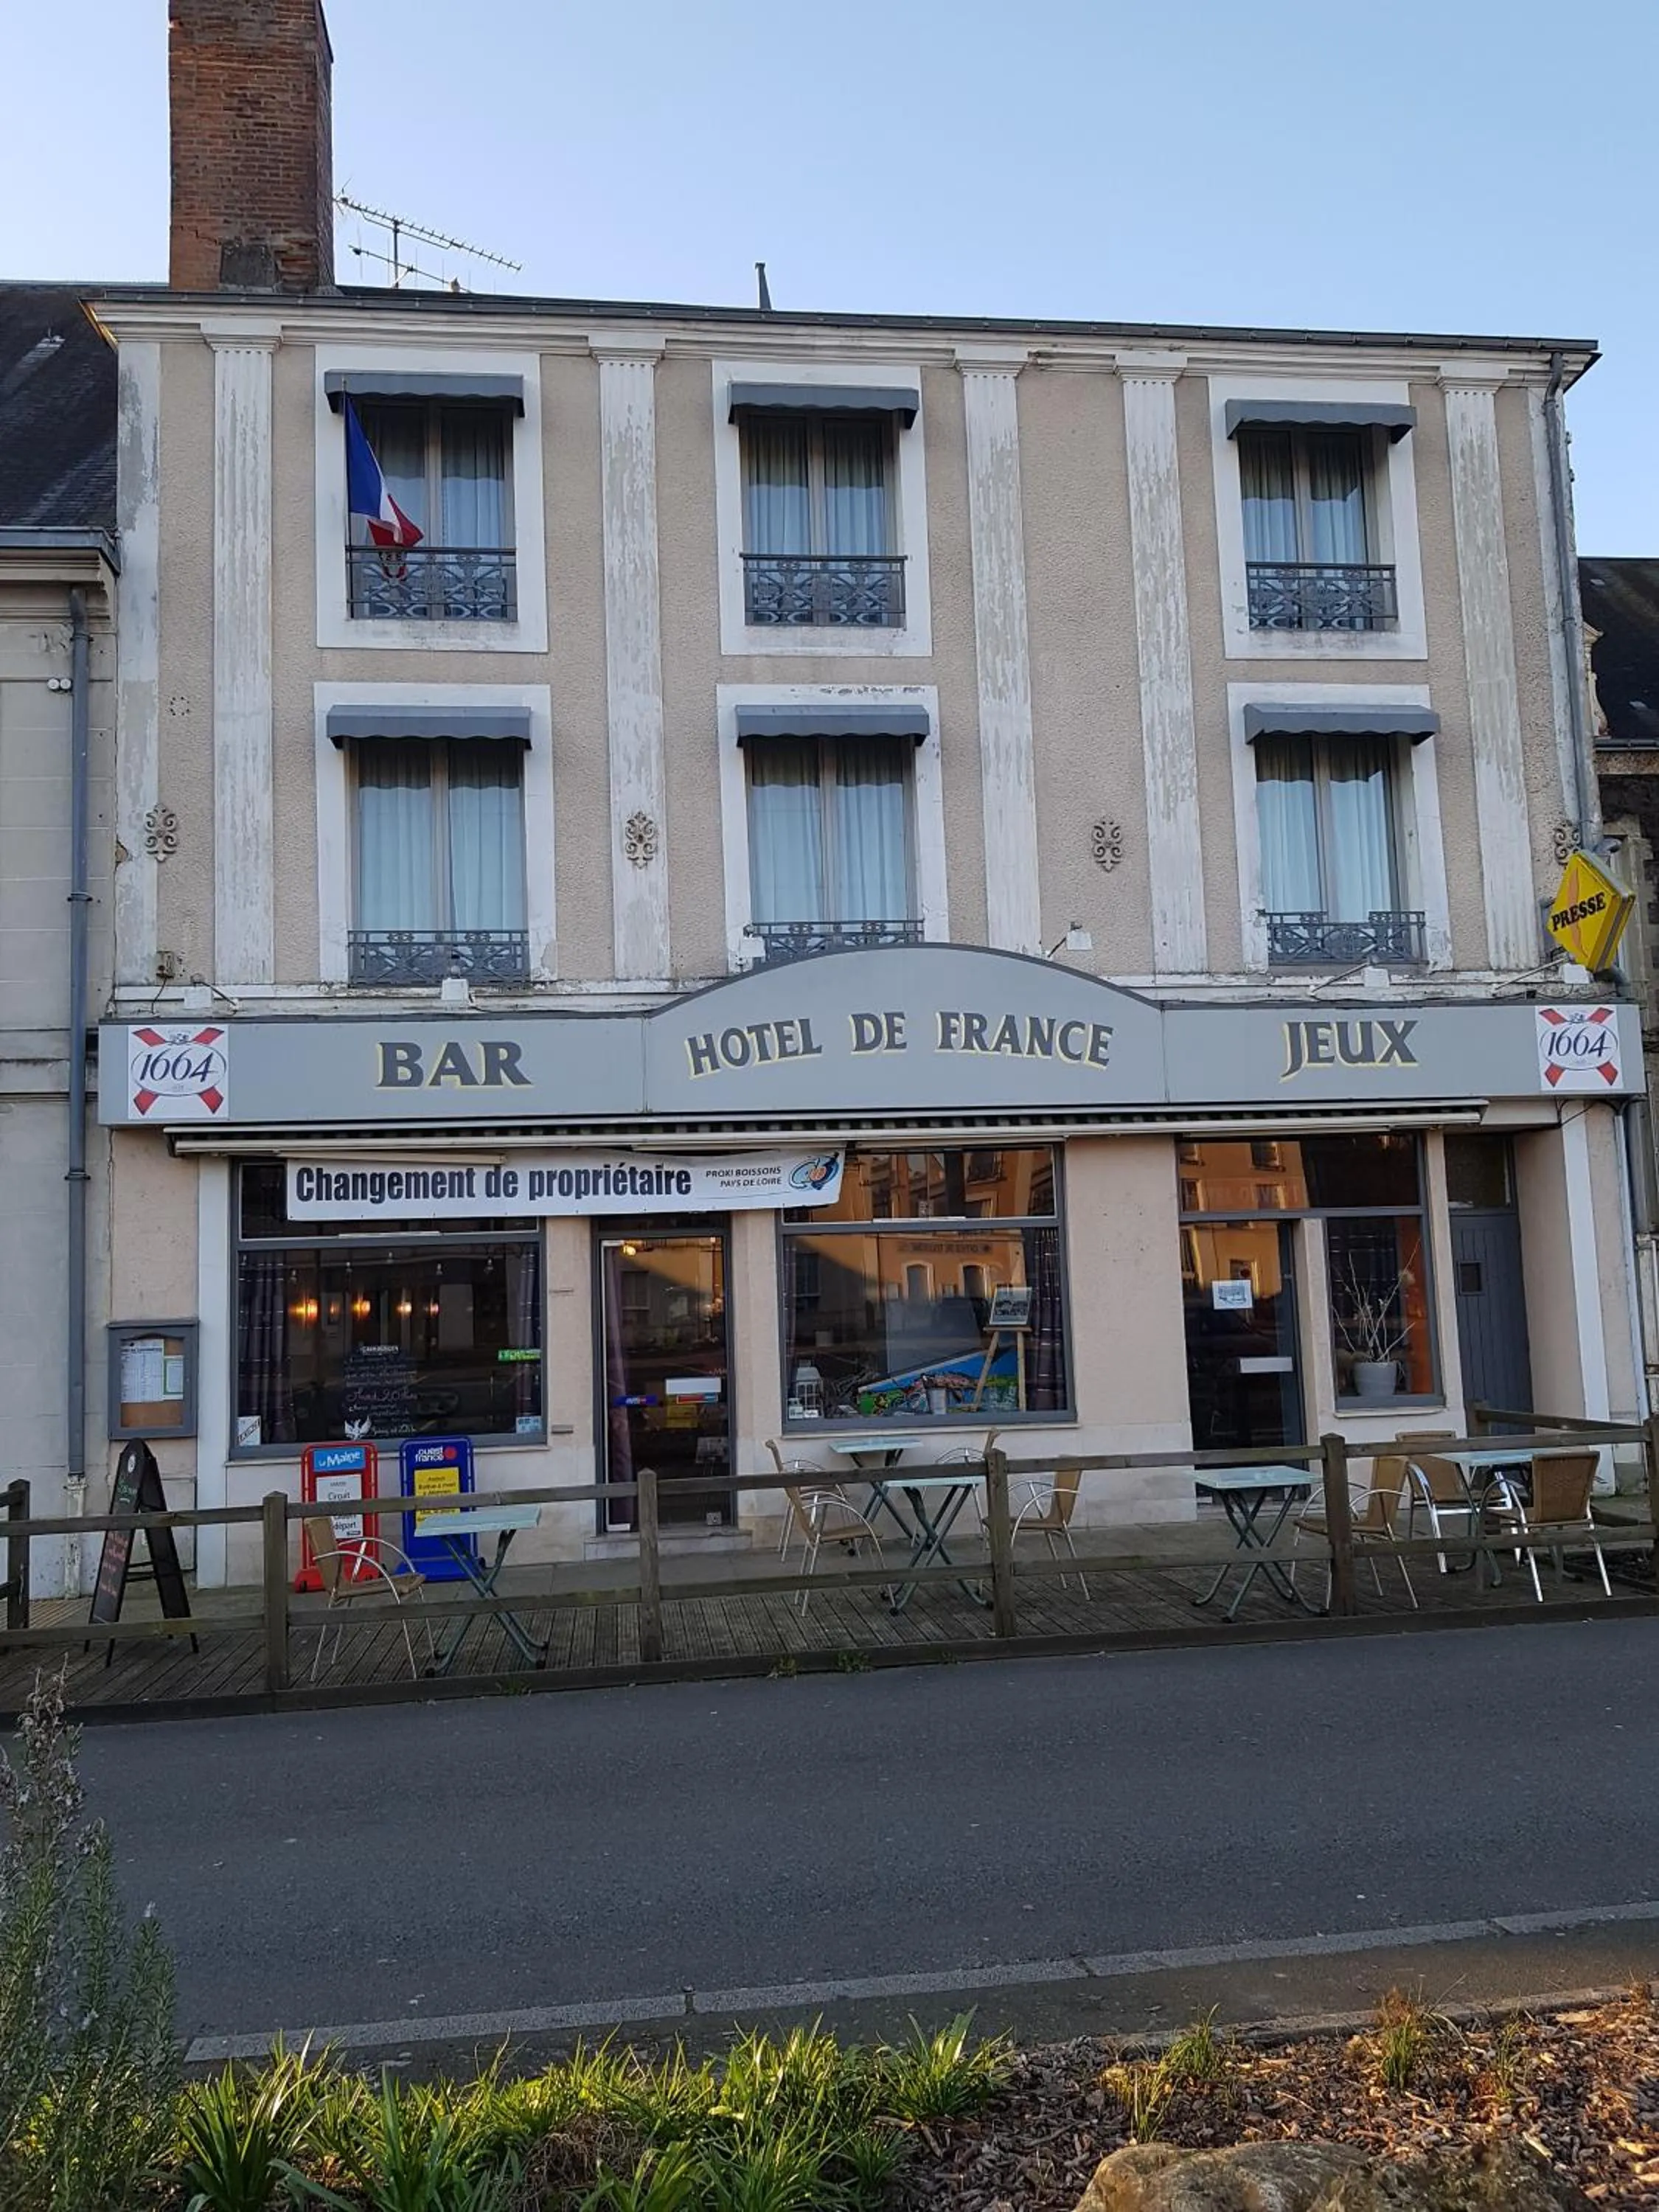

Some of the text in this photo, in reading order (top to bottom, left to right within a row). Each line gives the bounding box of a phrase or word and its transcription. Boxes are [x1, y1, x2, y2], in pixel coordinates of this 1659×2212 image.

[1551, 892, 1606, 932] PRESSE
[685, 1011, 1114, 1079] HOTEL DE FRANCE
[1279, 1020, 1420, 1083] JEUX
[1547, 1026, 1612, 1058] 1664
[139, 1048, 218, 1083] 1664
[374, 1041, 534, 1090] BAR
[296, 1163, 692, 1205] Changement de propriétaire
[706, 1166, 782, 1178] PROXI BOISSONS
[720, 1180, 742, 1188] PAYS
[757, 1178, 782, 1186] LOIRE
[327, 1450, 361, 1467] Maine
[415, 1453, 445, 1462] france
